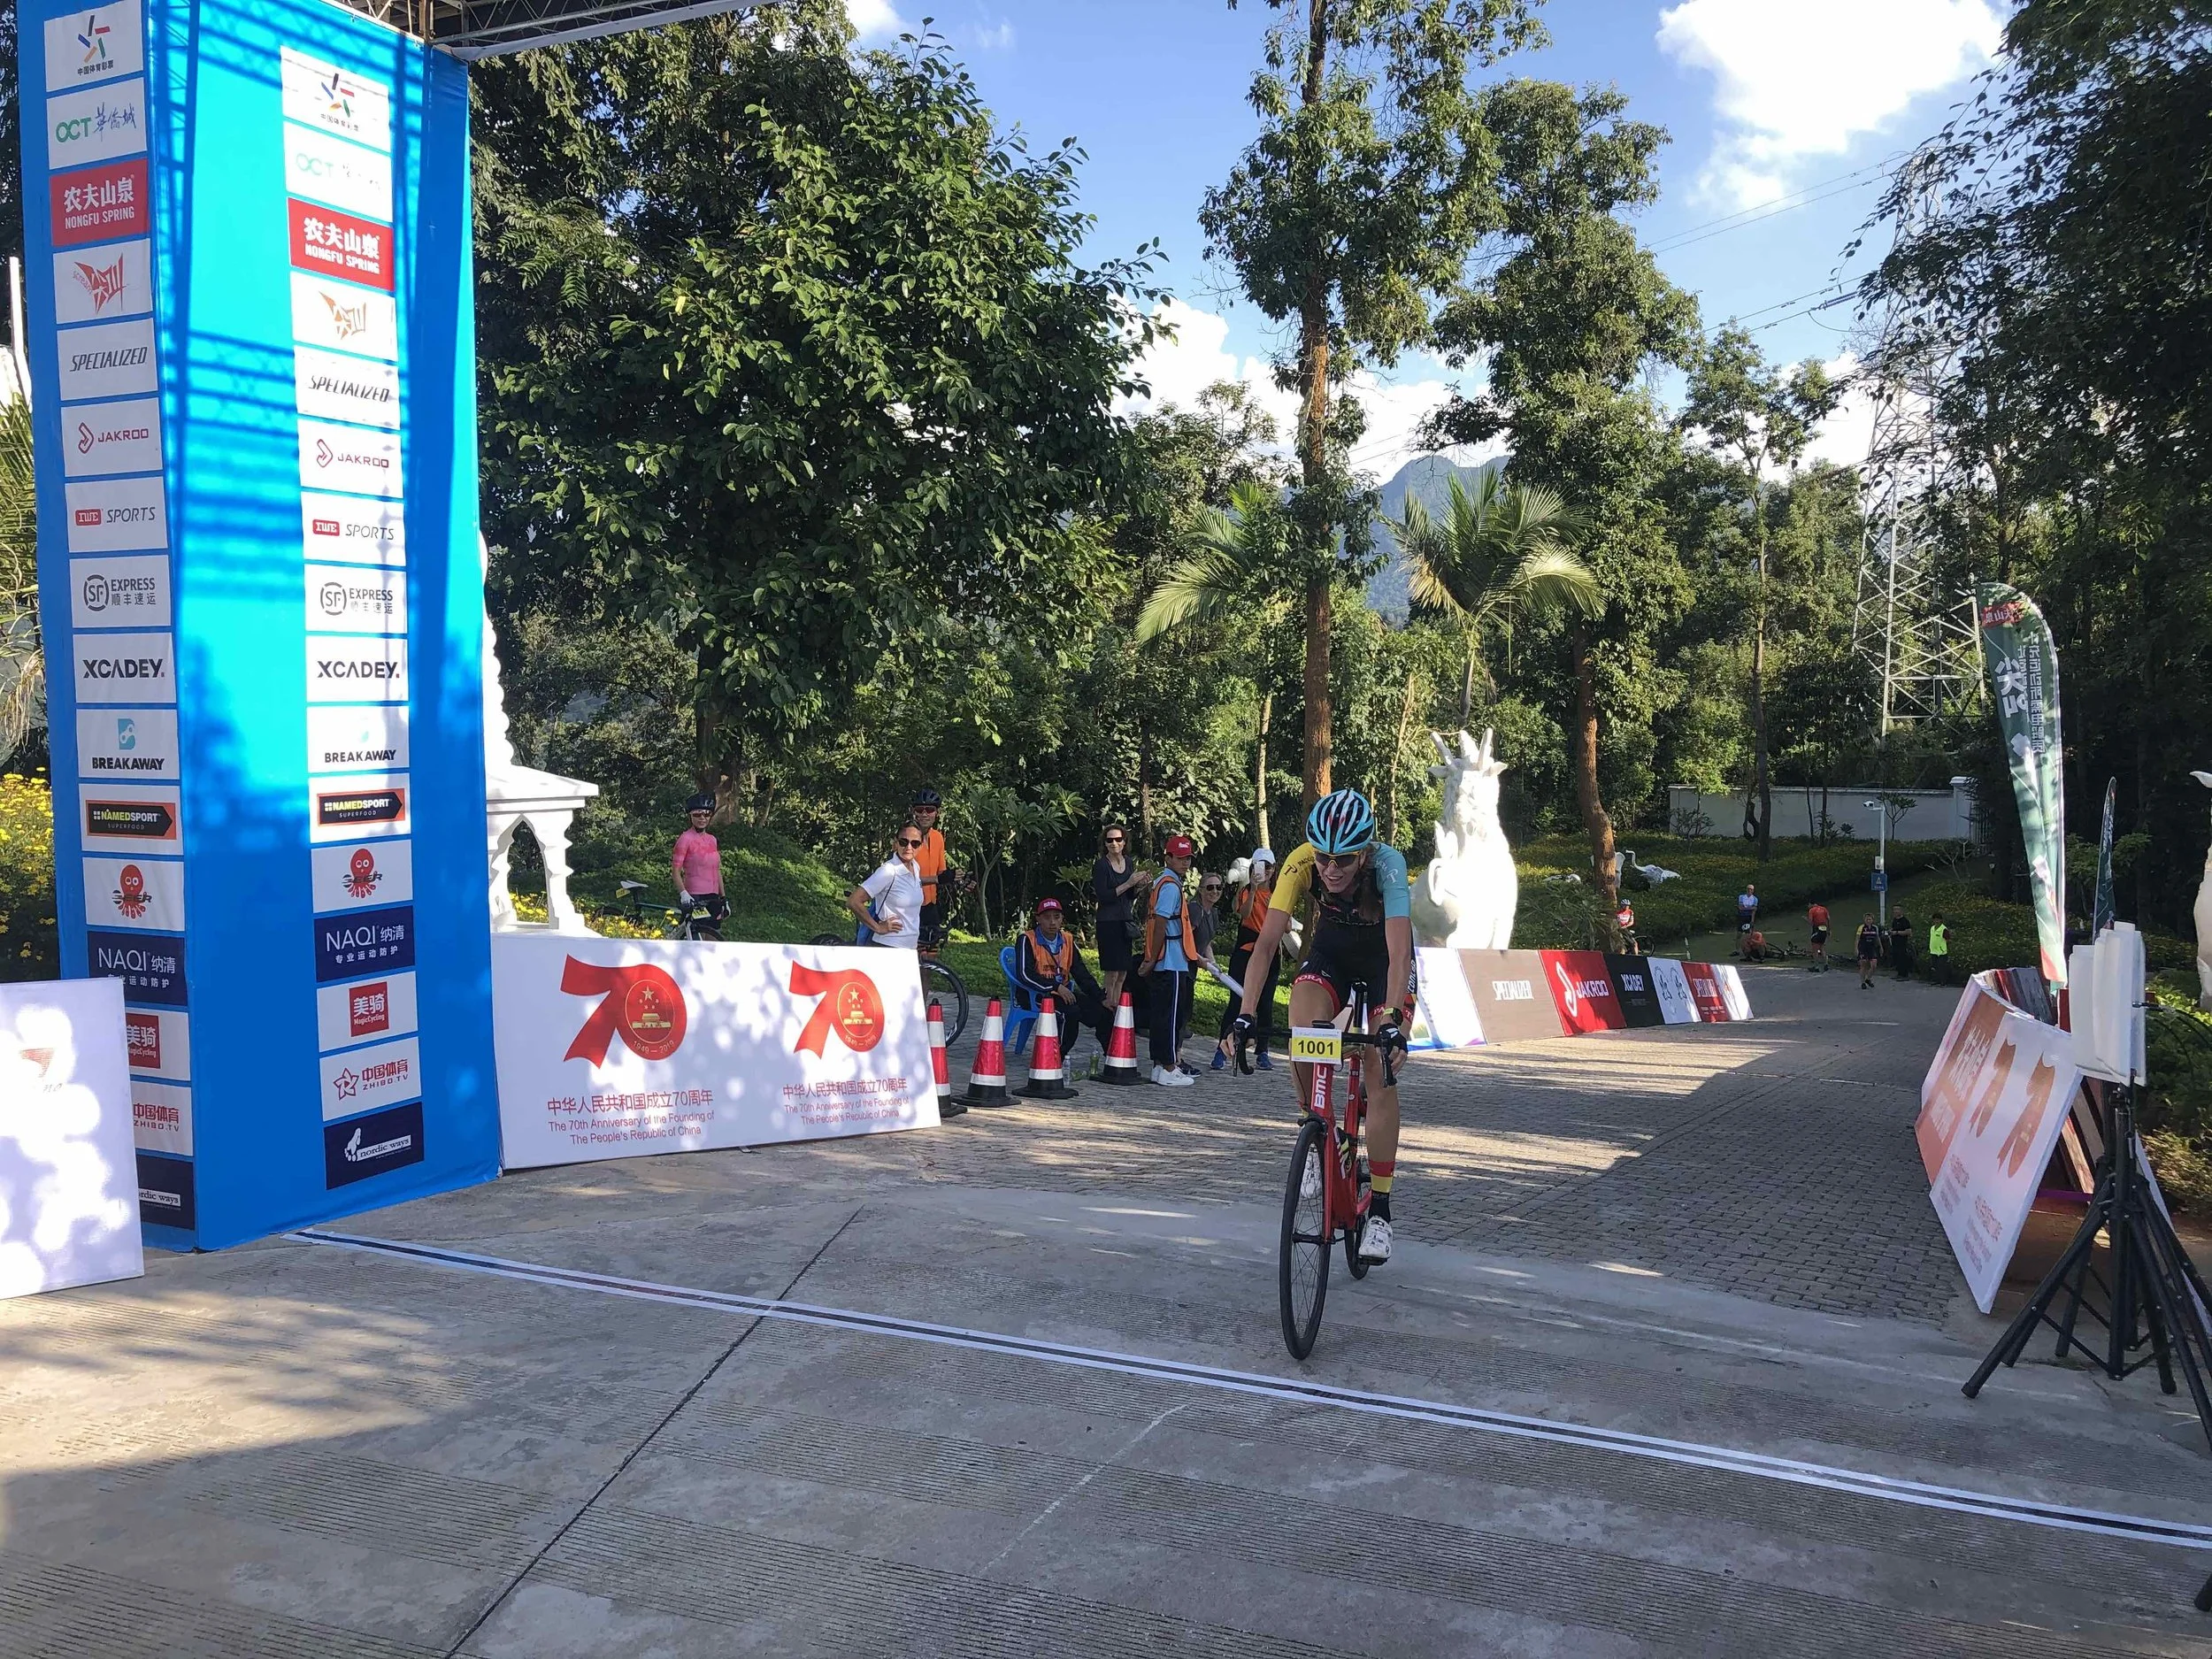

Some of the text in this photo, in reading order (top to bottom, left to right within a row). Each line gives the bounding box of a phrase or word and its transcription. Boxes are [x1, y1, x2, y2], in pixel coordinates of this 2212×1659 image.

[78, 60, 113, 75] 中国体育彩票
[56, 118, 91, 142] OCT
[64, 177, 134, 212] 农夫山泉
[65, 206, 134, 229] NONGFU SPRING
[303, 218, 380, 260] 农夫山泉
[305, 243, 380, 275] NONGFU SPRING
[69, 347, 148, 373] SPECIALIZED
[308, 375, 389, 403] SPECIALIZED
[98, 428, 149, 442] JAKROO
[338, 453, 389, 468] JAKROO
[106, 507, 156, 523] SPORTS
[345, 524, 395, 540] SPORTS
[111, 578, 156, 592] EXPRESS
[349, 588, 393, 602] EXPRESS
[111, 593, 156, 606] 顺丰速运
[92, 757, 165, 771] BREAKAWAY
[325, 749, 397, 763] BREAKAWAY
[333, 798, 390, 811] NAMEDSPORT
[101, 809, 158, 823] NAMEDSPORT
[326, 926, 376, 952] NAQI
[380, 925, 404, 942] 纳清
[98, 948, 147, 972] NAQI
[151, 956, 176, 973] 纳清
[335, 945, 398, 964] 专业运动防护
[1576, 979, 1609, 999] JAKROO
[354, 993, 385, 1018] 美骑
[560, 954, 687, 1069] 70
[789, 959, 885, 1060] 70
[127, 1025, 157, 1048] 美骑
[1297, 1040, 1333, 1056] 1001
[362, 1059, 408, 1082] 中国体育
[783, 1078, 908, 1100] 中华人民共和国成立70周年
[1314, 1064, 1327, 1109] BMC
[548, 1089, 713, 1116] 中华人民共和国成立70周年
[784, 1096, 910, 1114] The 70th Anniversary of the Founding of
[134, 1103, 179, 1124] 中国体育
[549, 1110, 714, 1132] The 70th Anniversary of the Founding of
[801, 1109, 899, 1125] The People's Republic of China
[570, 1125, 702, 1145] The People's Republic of China
[360, 1144, 388, 1157] nordic
[389, 1138, 410, 1150] ways
[139, 1190, 179, 1204] rdic ways
